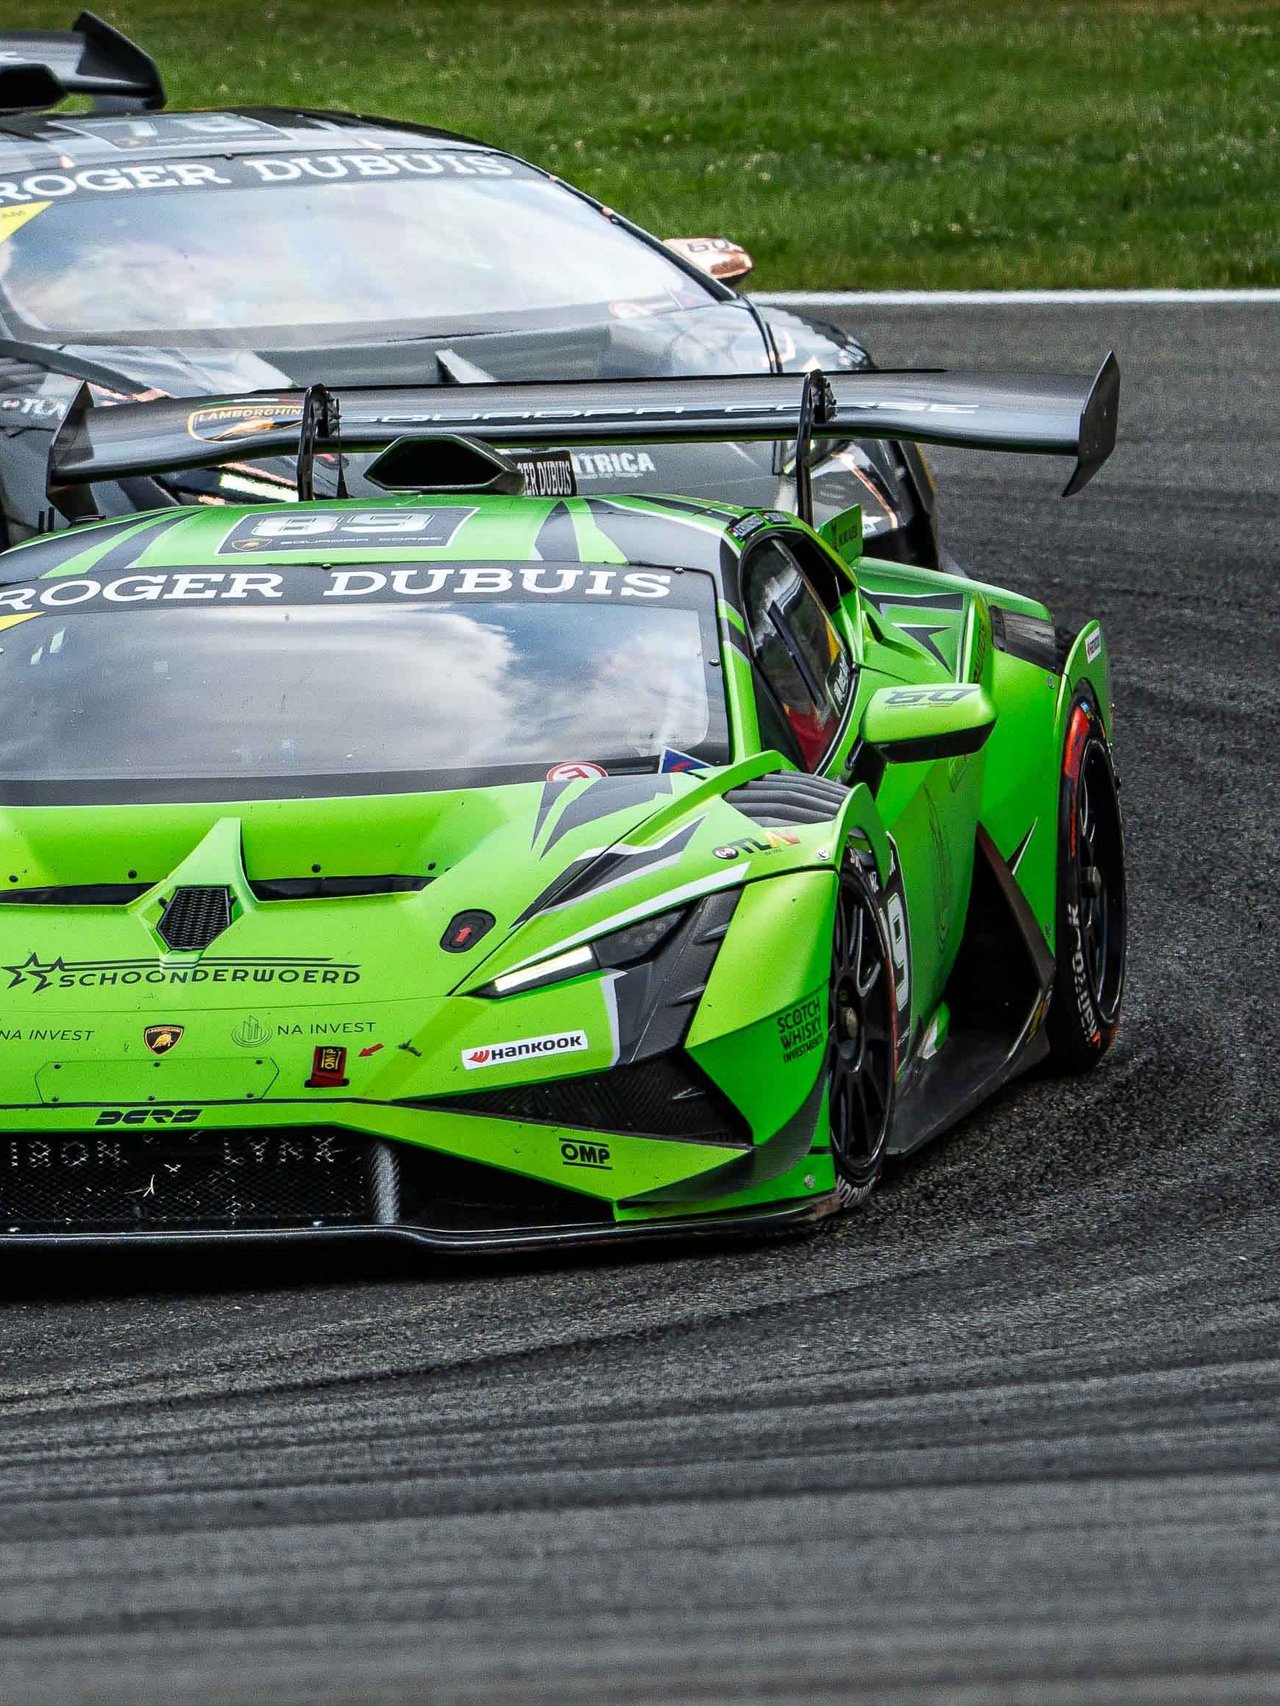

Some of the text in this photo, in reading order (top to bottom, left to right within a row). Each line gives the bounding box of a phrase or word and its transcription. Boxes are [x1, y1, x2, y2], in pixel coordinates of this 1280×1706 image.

[244, 151, 513, 184] DUBUIS
[198, 406, 305, 421] LAMBORGHIN
[251, 513, 436, 537] 89
[322, 567, 672, 598] DUBUIS
[59, 968, 362, 989] SCHOONDERWOERD
[777, 996, 821, 1033] SCOTCH
[30, 1029, 95, 1041] INVEST
[276, 1021, 377, 1037] NA INVEST
[561, 1143, 611, 1165] OMP
